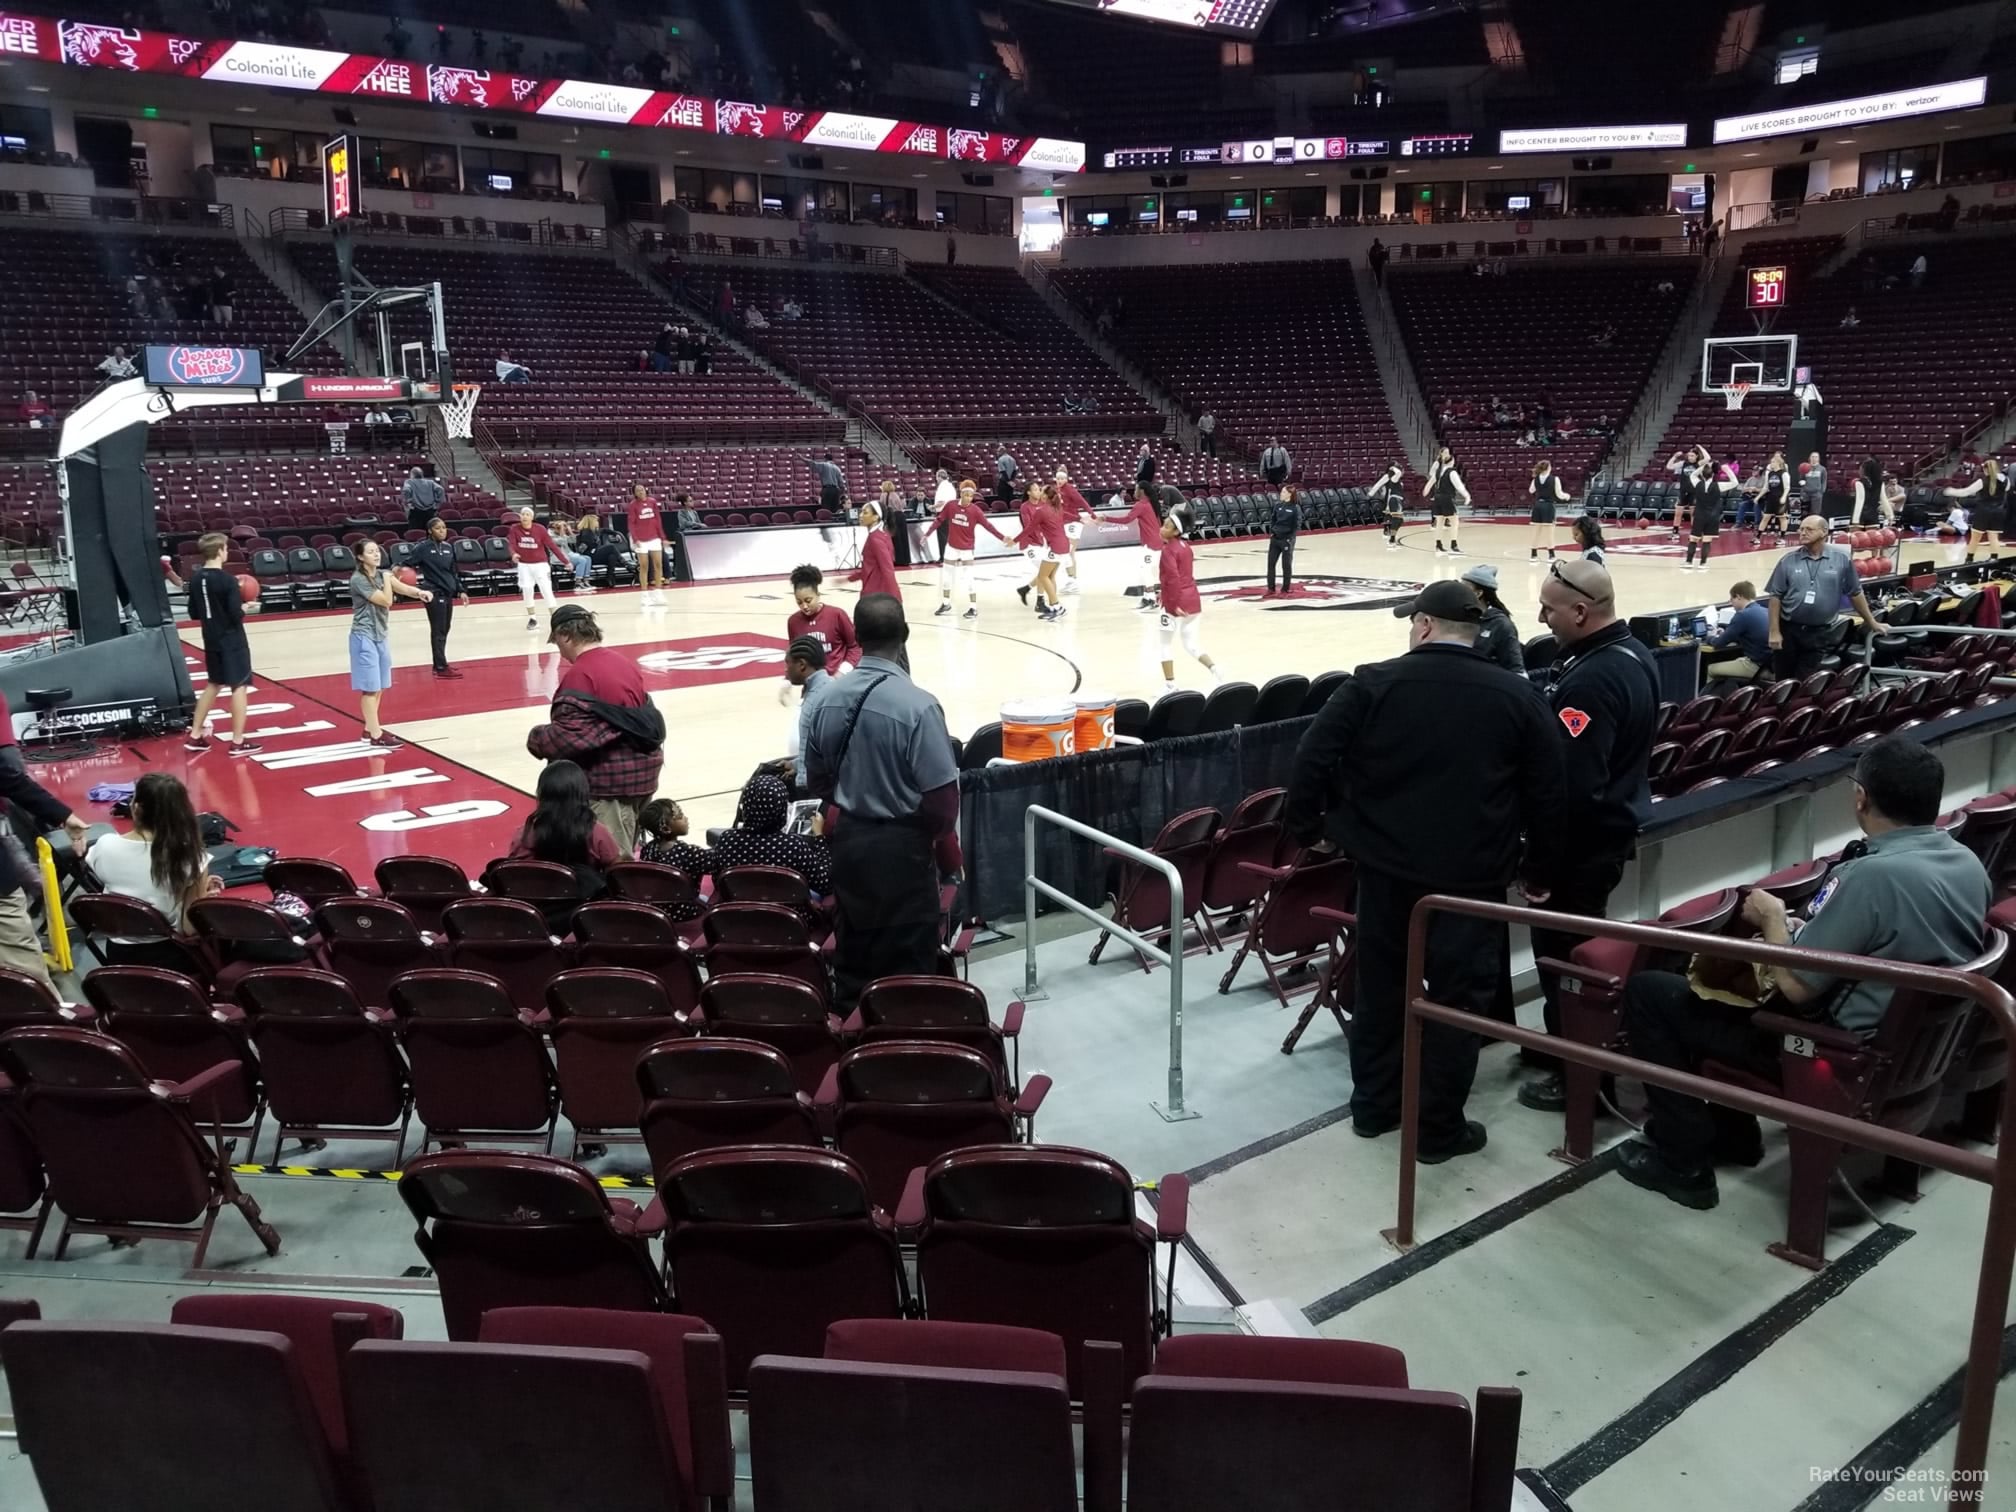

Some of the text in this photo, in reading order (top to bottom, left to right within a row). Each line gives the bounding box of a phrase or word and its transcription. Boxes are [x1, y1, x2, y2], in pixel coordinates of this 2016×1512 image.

[0, 18, 37, 35] VER
[225, 58, 317, 80] Colonial Life
[555, 95, 628, 114] Colonial Life
[1740, 95, 1939, 133] LIVE SCORES BROUGHT TO YOU BY: verizon
[818, 125, 877, 142] Colonial Life
[1506, 138, 1525, 146] INFO
[1527, 137, 1558, 145] CENTER
[1559, 136, 1597, 144] BROUGHT
[1611, 134, 1629, 142] YOU
[1030, 150, 1079, 165] Colonial Life
[1252, 144, 1265, 159] 0
[1303, 142, 1316, 157] 0
[1753, 270, 1783, 283] 48:09
[1756, 282, 1778, 303] 30
[178, 348, 234, 364] Jersey
[322, 384, 395, 392] UNDER ARMOUR
[1793, 1037, 1805, 1053] 2
